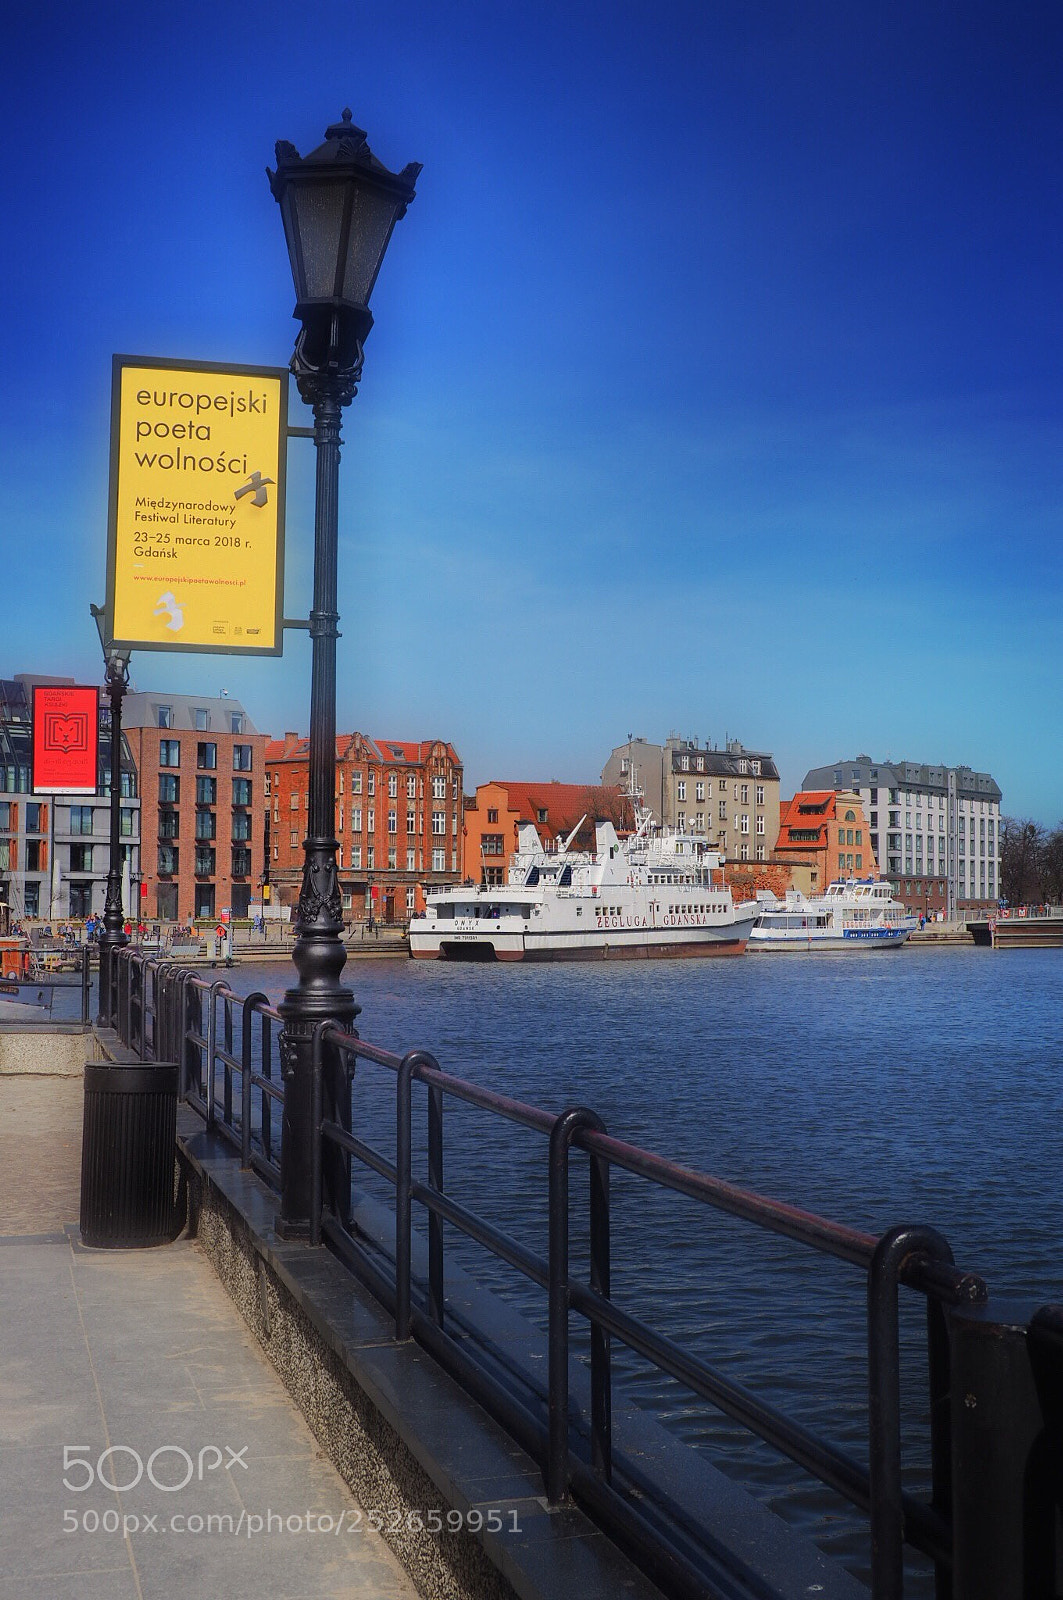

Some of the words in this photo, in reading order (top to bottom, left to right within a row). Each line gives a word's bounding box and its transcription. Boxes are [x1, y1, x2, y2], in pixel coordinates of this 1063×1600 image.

[136, 388, 267, 418] europejski
[135, 420, 211, 442] poeta
[134, 447, 248, 474] wolności
[135, 496, 236, 515] Międzynarodowy
[134, 511, 179, 524] Festiwal
[183, 513, 237, 529] Literatury
[175, 535, 211, 546] marca
[214, 536, 241, 548] 2018
[245, 540, 252, 549] r.
[133, 546, 178, 559] Gdańsk
[454, 919, 480, 927] ONYX
